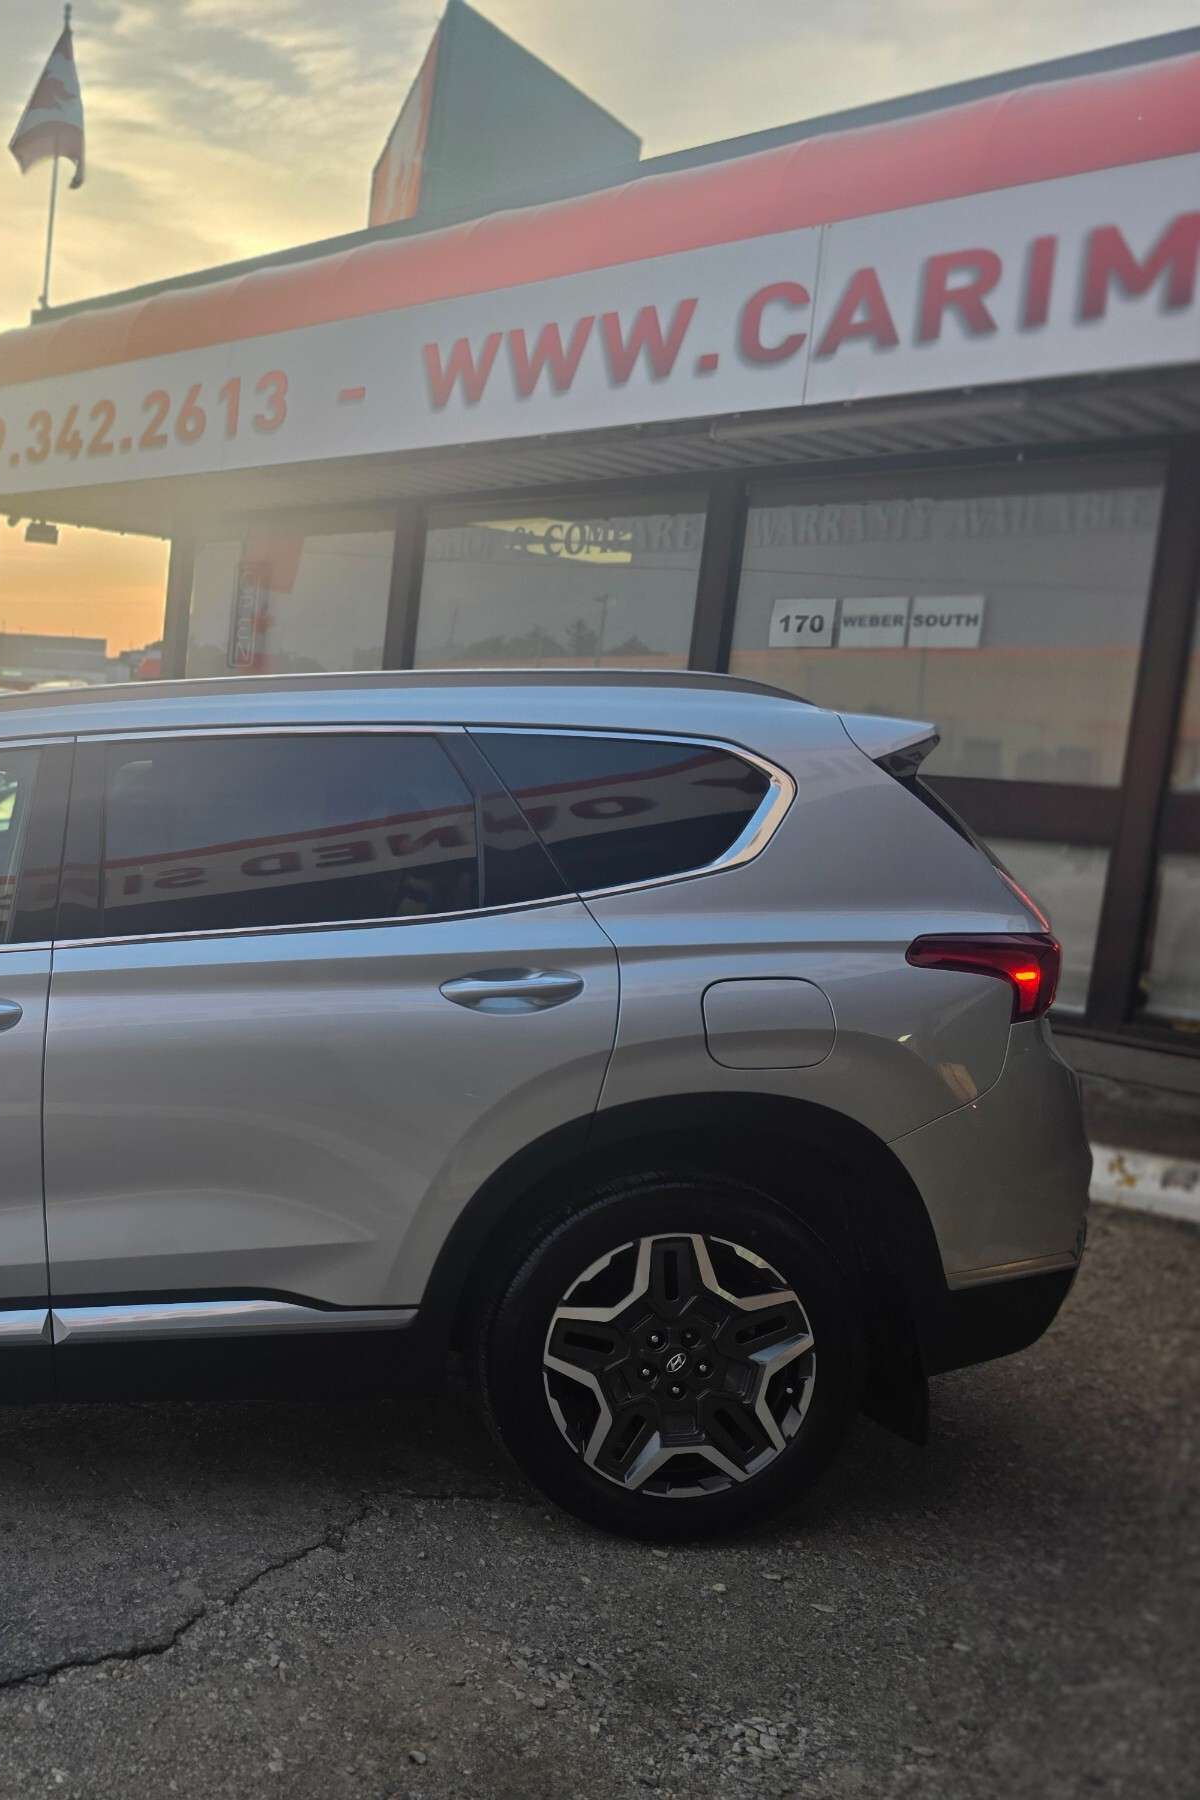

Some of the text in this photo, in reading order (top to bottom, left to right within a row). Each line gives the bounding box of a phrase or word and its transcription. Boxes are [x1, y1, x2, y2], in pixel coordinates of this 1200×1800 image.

[422, 210, 1200, 410] WWW.CARIM
[779, 613, 980, 633] 170 WEBER SOUTH
